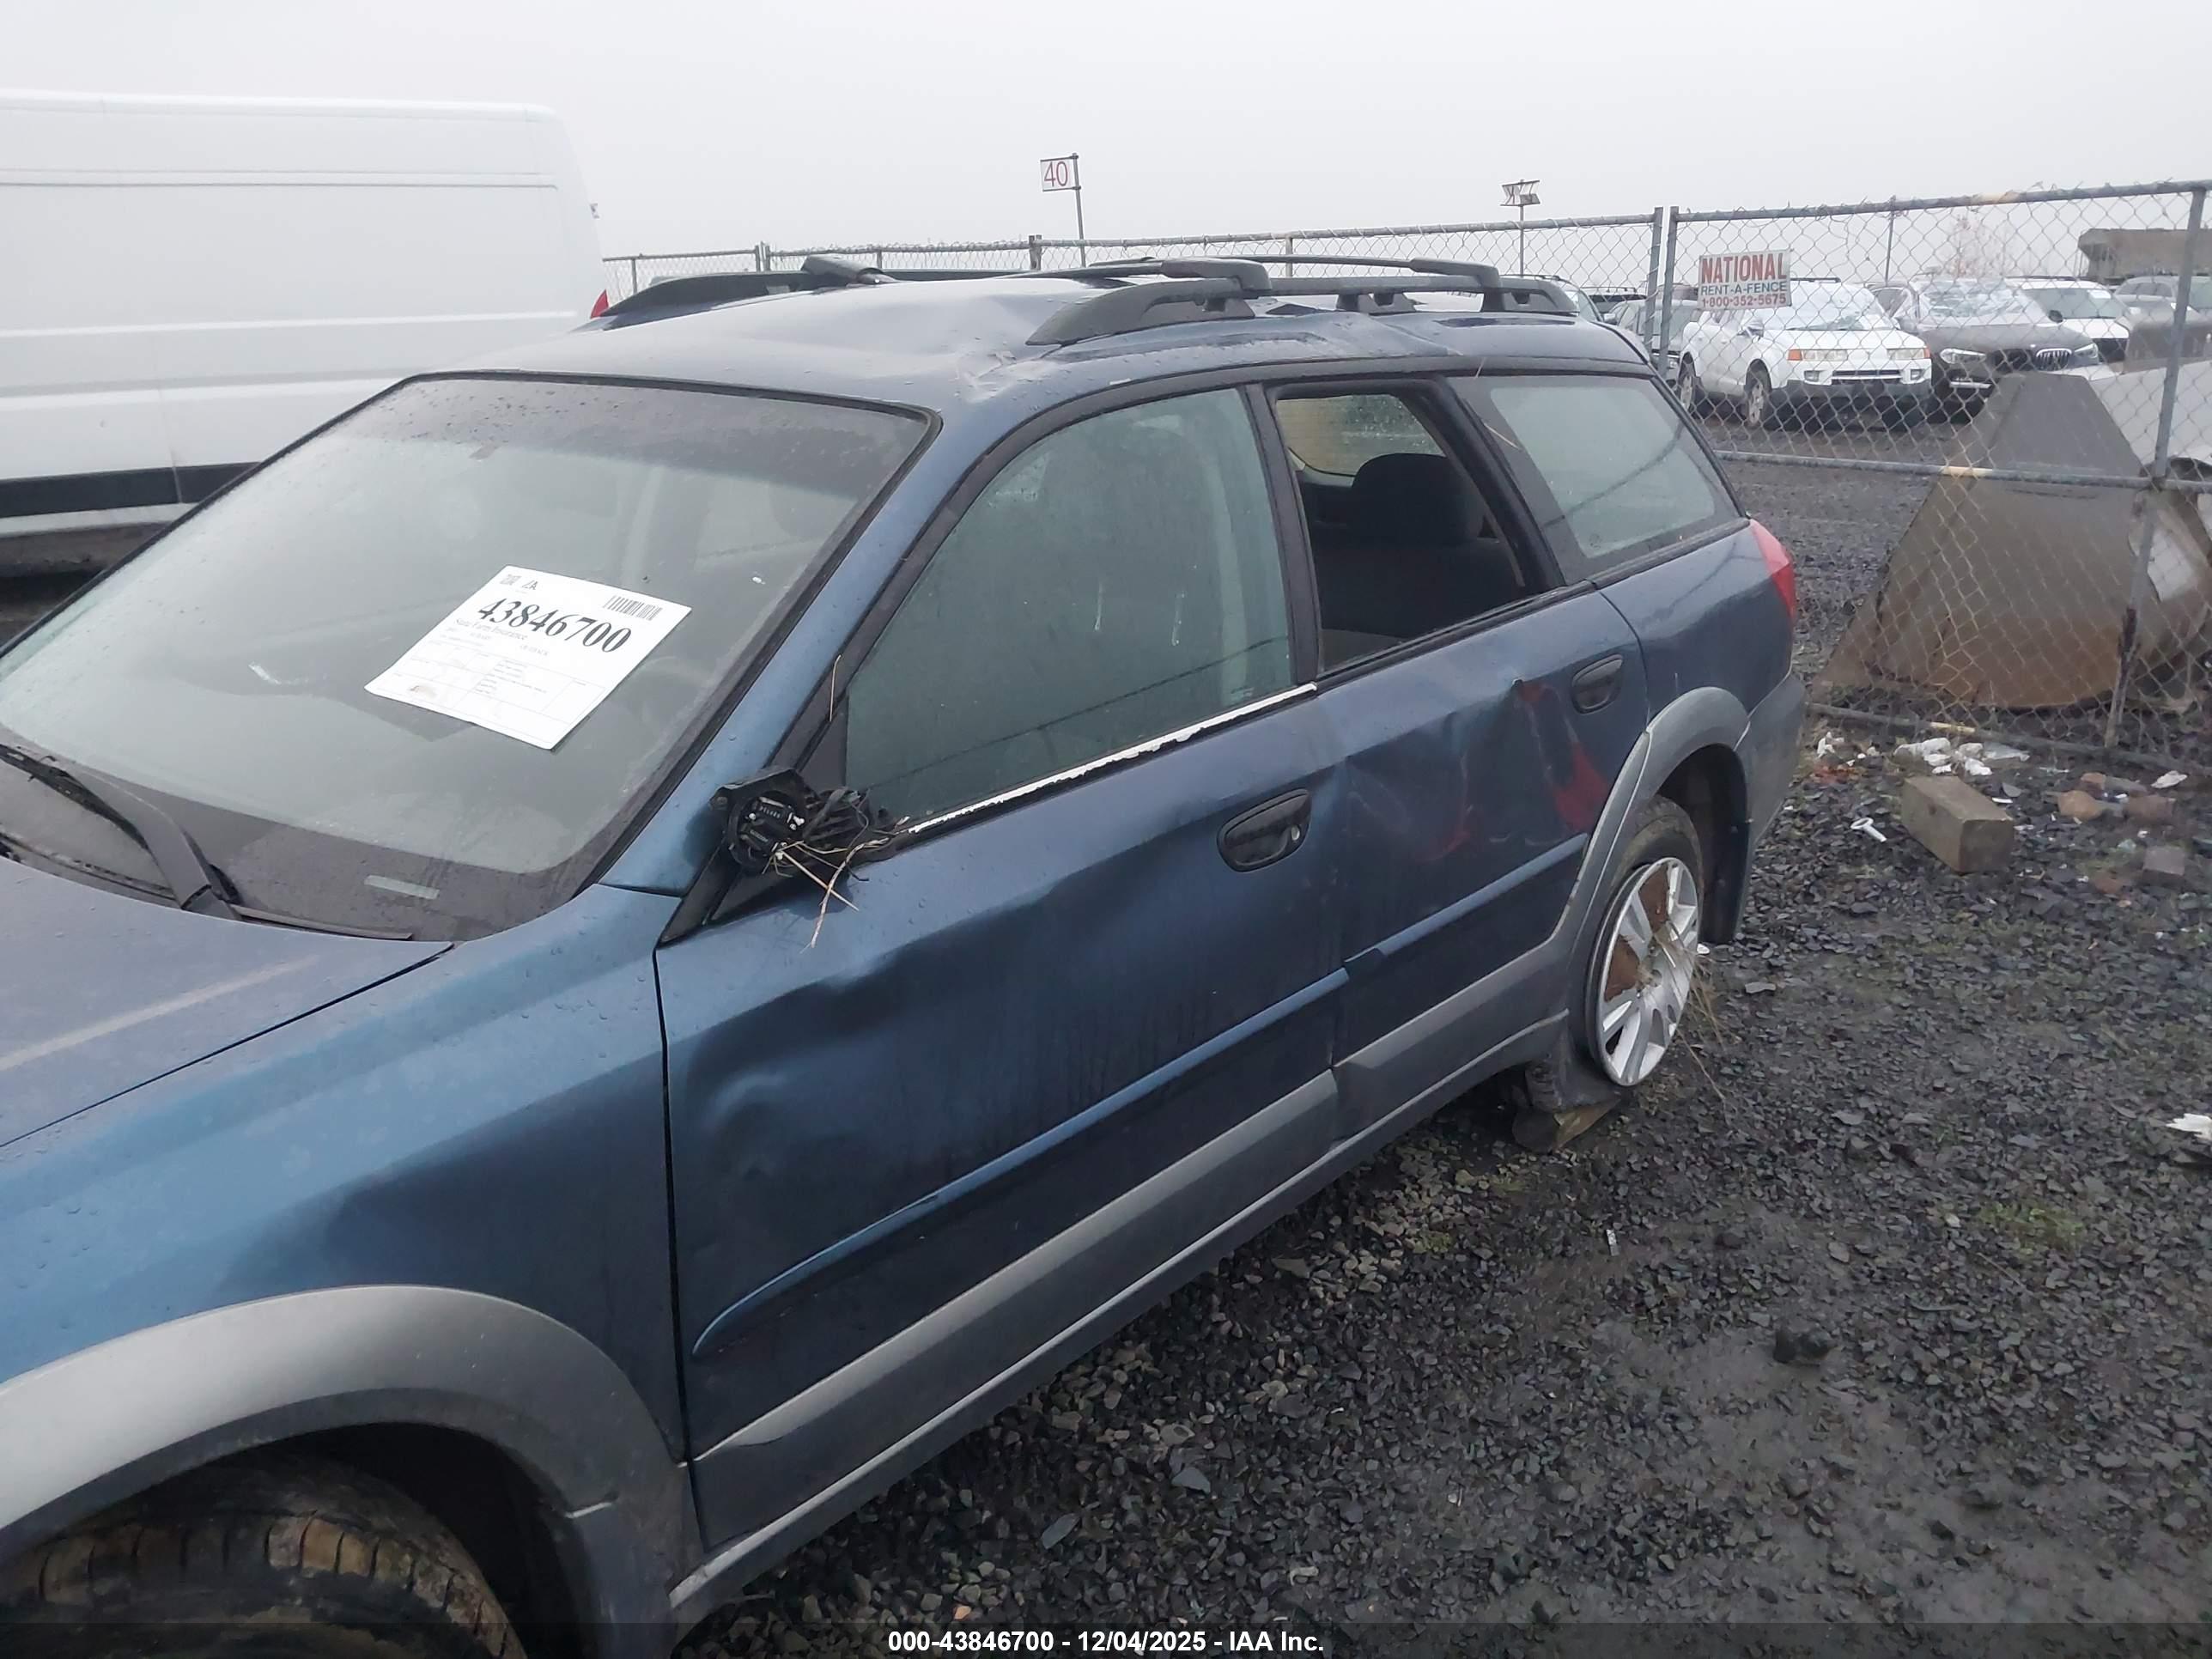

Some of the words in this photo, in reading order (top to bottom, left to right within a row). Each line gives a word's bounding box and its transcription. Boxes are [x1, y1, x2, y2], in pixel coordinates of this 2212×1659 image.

[1044, 161, 1068, 187] 40
[1701, 252, 1787, 283] NATIONAL
[1701, 281, 1788, 295] RENT-A-FENCE
[477, 599, 632, 653] 43846700
